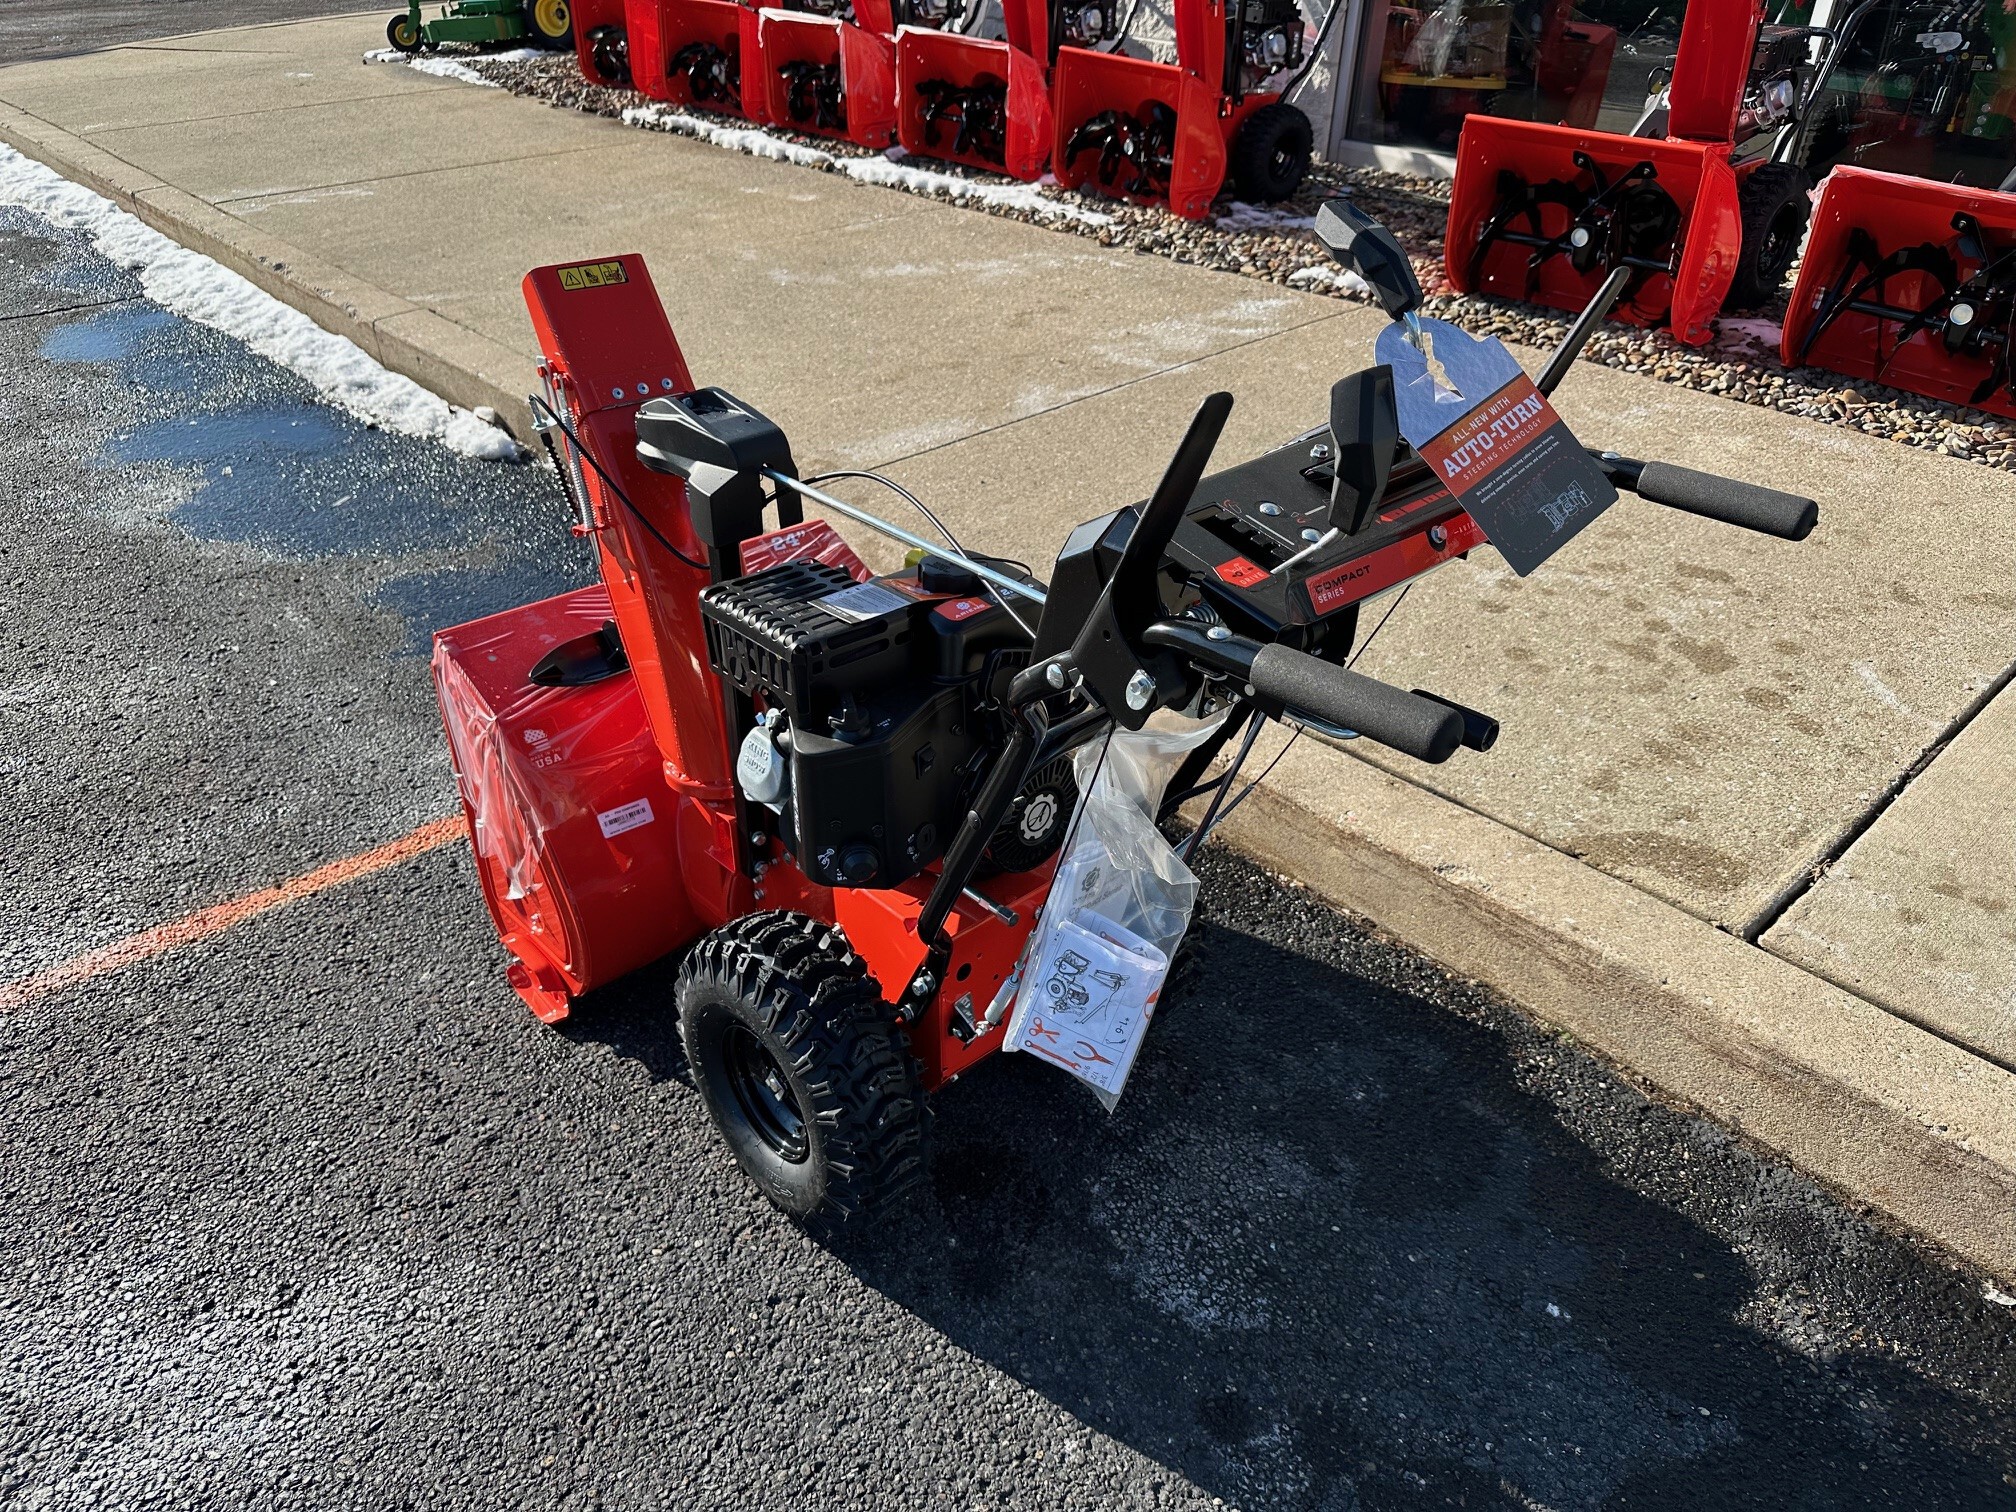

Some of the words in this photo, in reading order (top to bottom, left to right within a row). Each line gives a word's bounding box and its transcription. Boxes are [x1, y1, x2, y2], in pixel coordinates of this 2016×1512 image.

[1452, 412, 1489, 444] ALL-NEW
[1488, 397, 1511, 416] WITH
[1442, 393, 1544, 478] AUTO-TURN
[1463, 453, 1498, 480] STEERING
[1499, 418, 1542, 453] TECHNOLOGY
[1239, 571, 1265, 585] DRIVE
[1314, 564, 1371, 593] COMPACT
[1317, 586, 1345, 604] SERIES
[955, 603, 986, 620] ARIENS
[535, 752, 562, 768] USA
